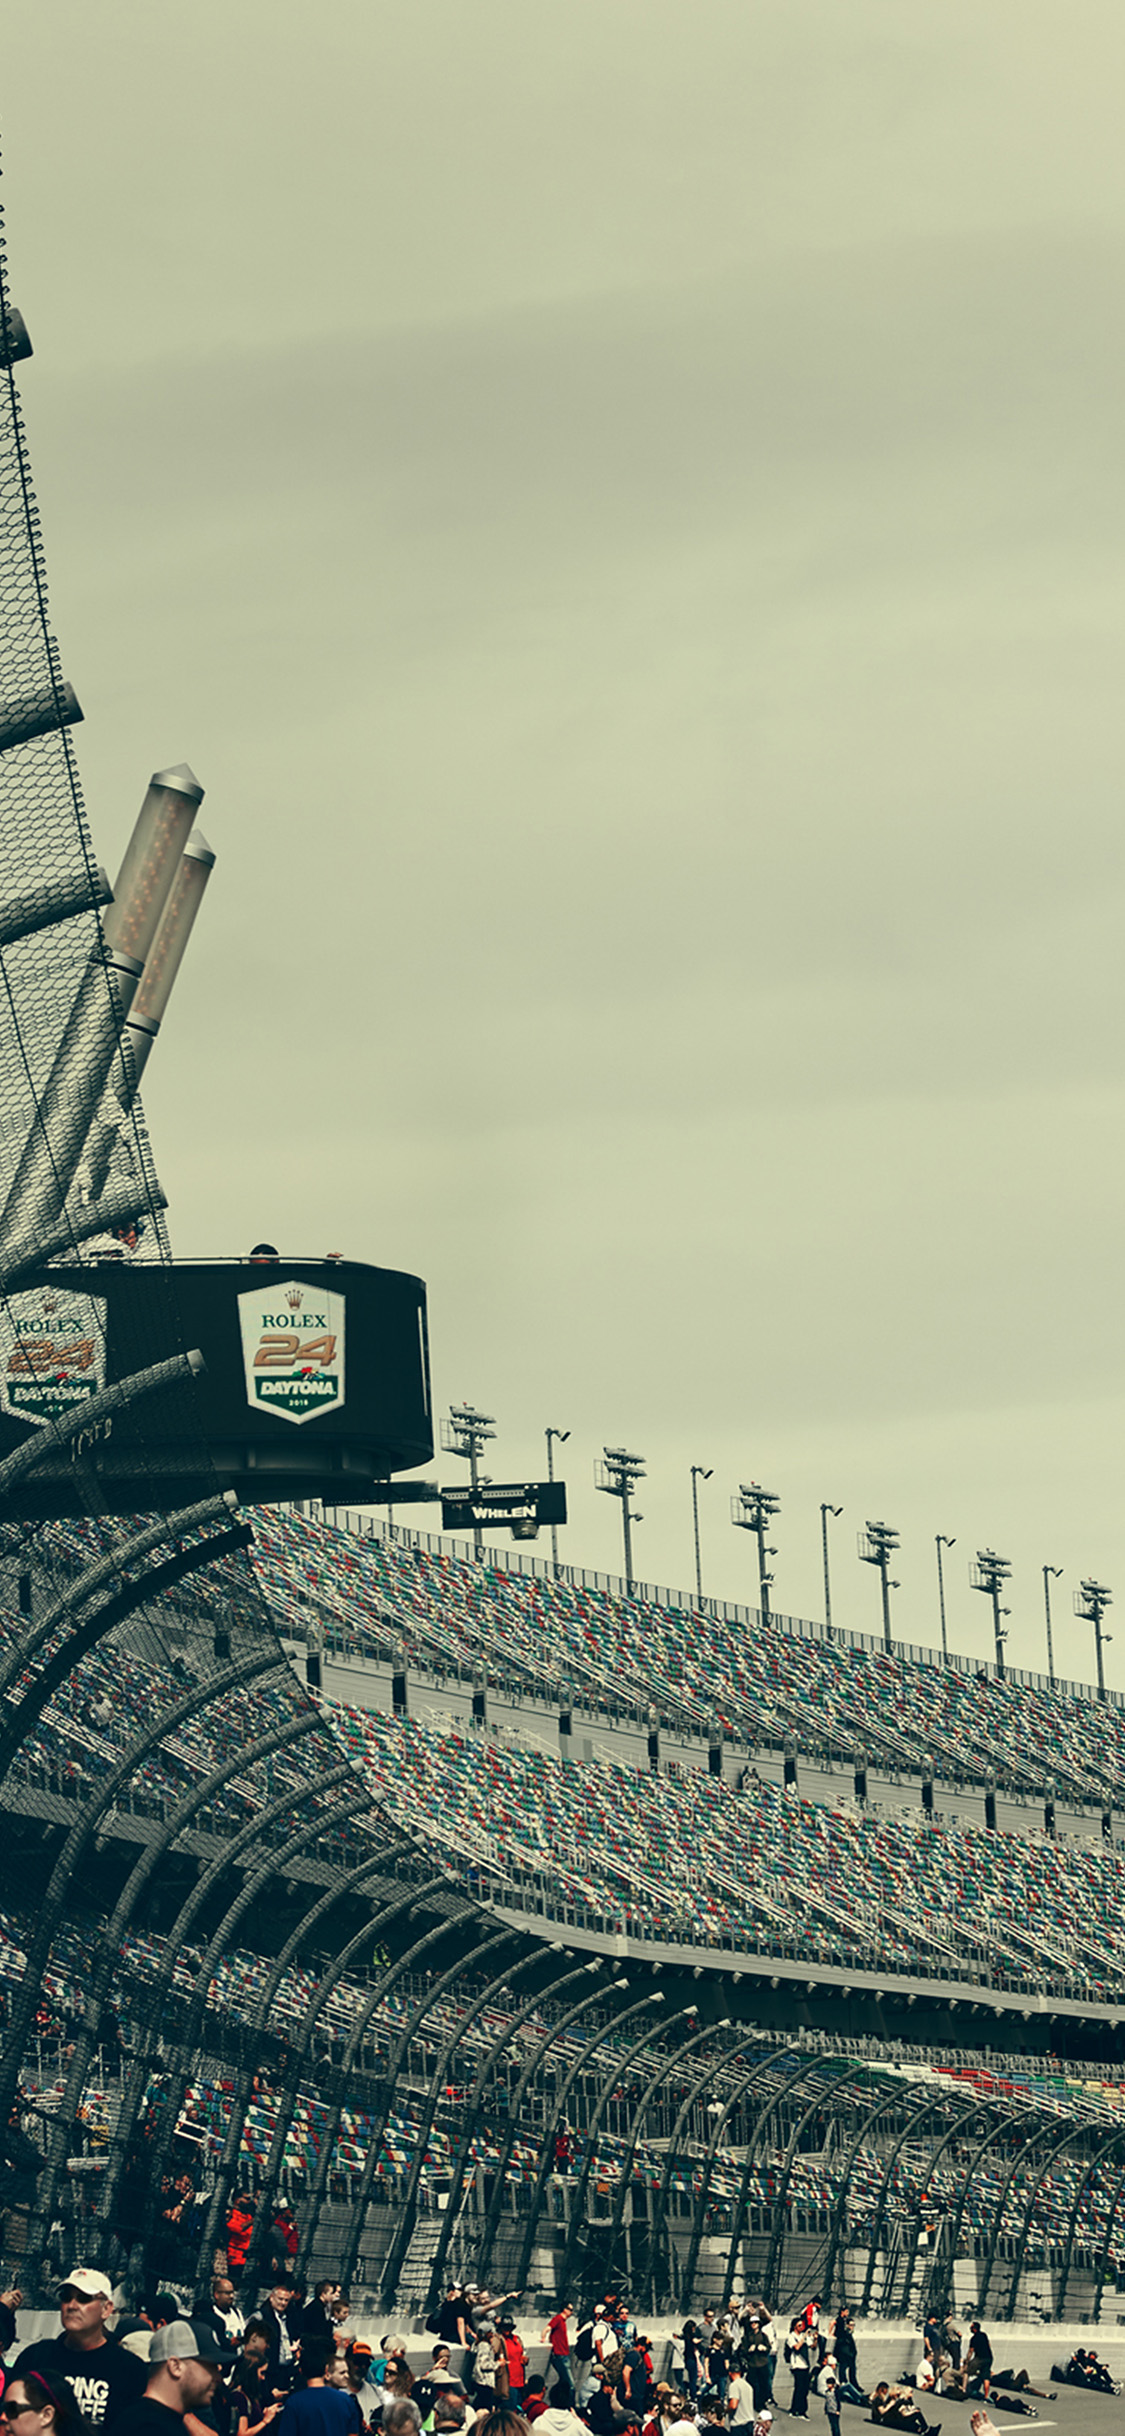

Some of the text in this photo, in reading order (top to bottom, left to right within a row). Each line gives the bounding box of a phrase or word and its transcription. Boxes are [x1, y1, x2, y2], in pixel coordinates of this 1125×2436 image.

[16, 1320, 84, 1333] ROLEX
[262, 1314, 327, 1328] ROLEX
[7, 1339, 96, 1372] 24
[253, 1334, 337, 1367] 24
[13, 1386, 90, 1401] DAYTONA
[260, 1381, 337, 1395] DAYTONA
